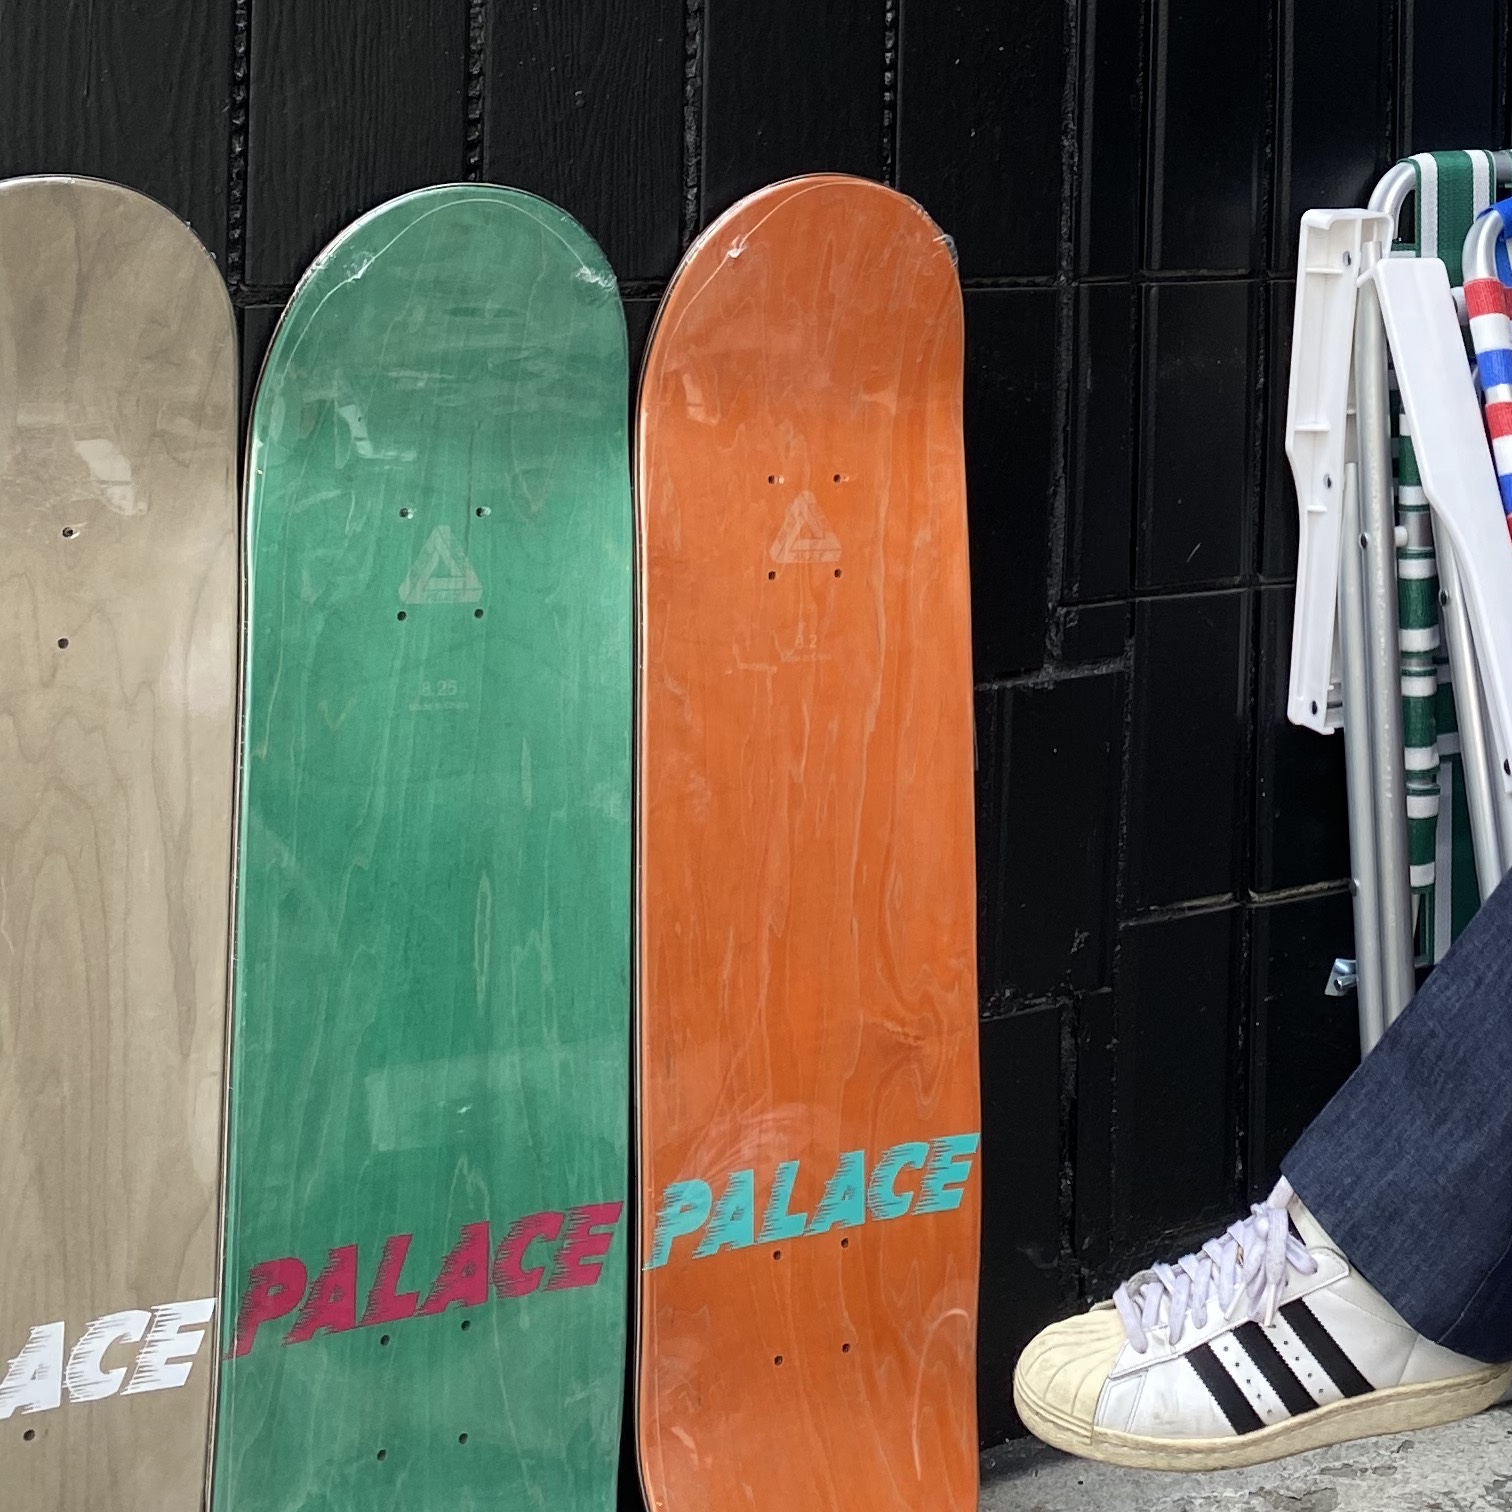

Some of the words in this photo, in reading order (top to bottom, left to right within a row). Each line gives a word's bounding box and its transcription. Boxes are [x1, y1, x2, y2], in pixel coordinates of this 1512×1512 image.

[421, 679, 458, 697] 8.25
[641, 1132, 981, 1272] PALACE
[222, 1201, 624, 1361] PALACE
[0, 1297, 218, 1420] ACE
